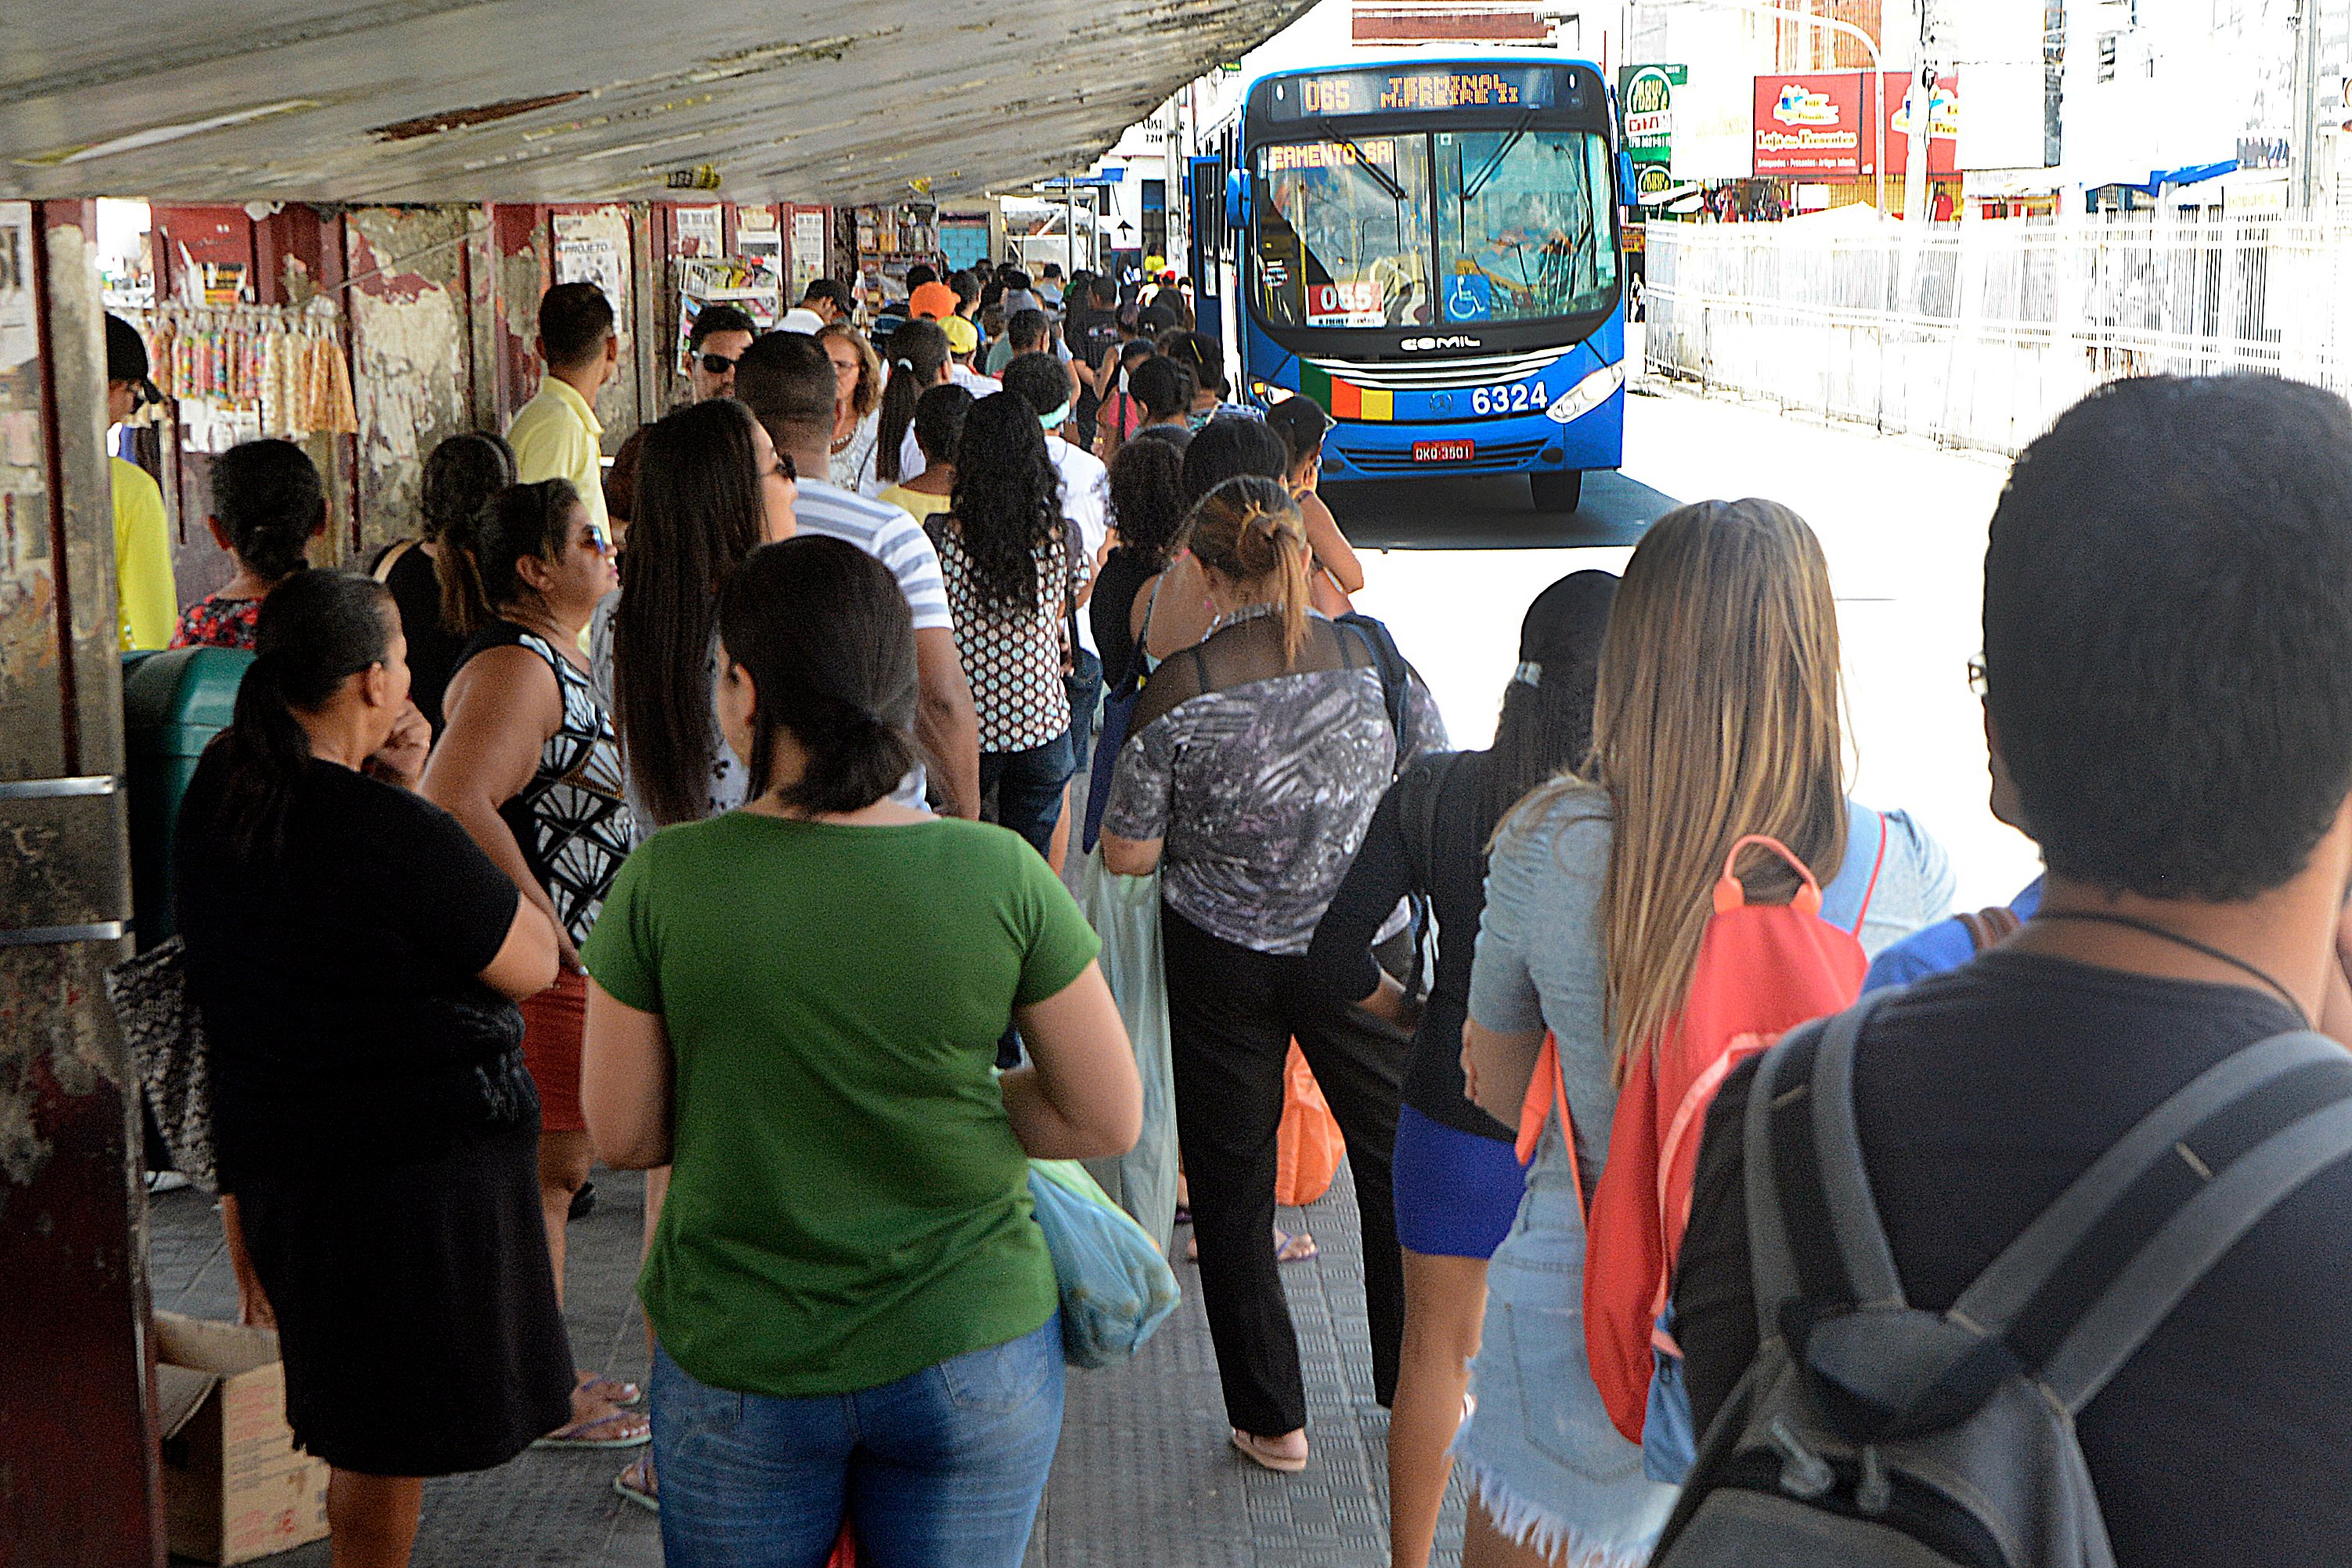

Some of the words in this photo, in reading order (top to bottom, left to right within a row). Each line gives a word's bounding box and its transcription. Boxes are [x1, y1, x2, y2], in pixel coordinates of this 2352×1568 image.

[1304, 80, 1349, 111] 065
[1758, 133, 1782, 147] Loja
[1320, 283, 1372, 312] 065
[1401, 335, 1481, 351] COMIL
[1472, 381, 1548, 415] 6324
